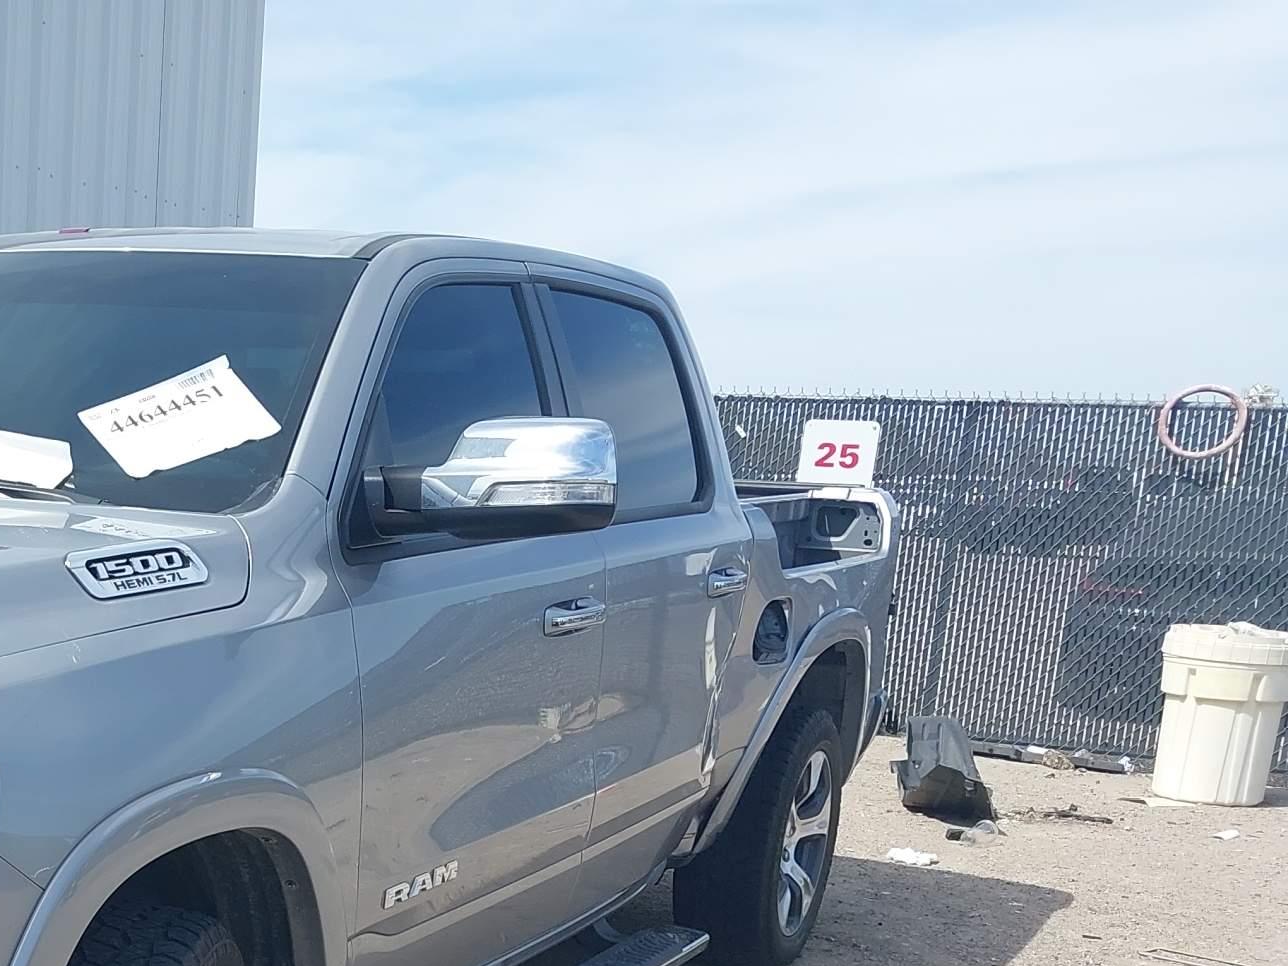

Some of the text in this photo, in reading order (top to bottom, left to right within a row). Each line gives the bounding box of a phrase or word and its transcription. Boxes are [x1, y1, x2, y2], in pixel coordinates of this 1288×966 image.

[110, 385, 224, 433] 44644451
[814, 442, 861, 469] 25
[88, 551, 184, 579] 1500
[113, 571, 188, 591] HEMI 5.7L
[382, 859, 459, 910] RAM
